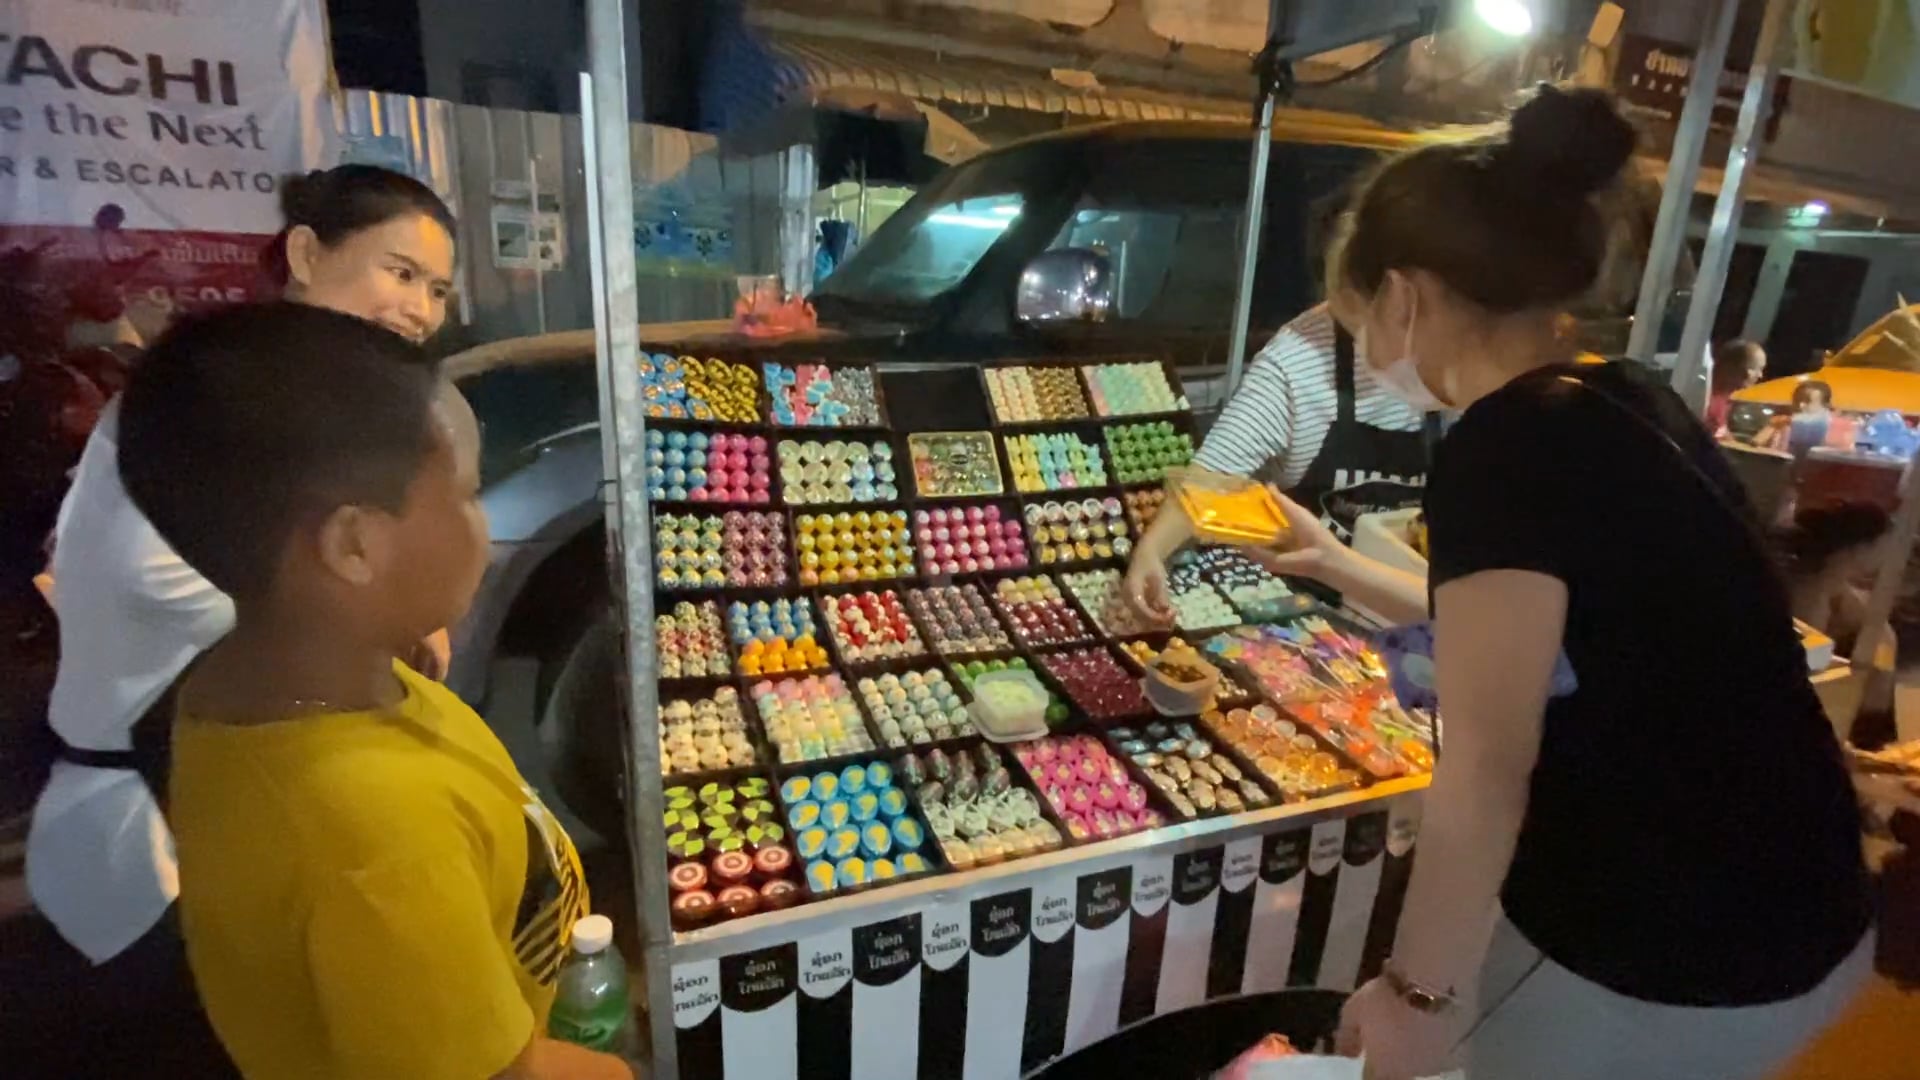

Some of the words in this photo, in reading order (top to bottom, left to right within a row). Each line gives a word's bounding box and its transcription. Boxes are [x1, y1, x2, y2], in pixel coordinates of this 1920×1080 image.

[0, 34, 239, 106] ACHI
[44, 102, 129, 140] the
[147, 110, 267, 151] Next
[35, 157, 58, 180] &
